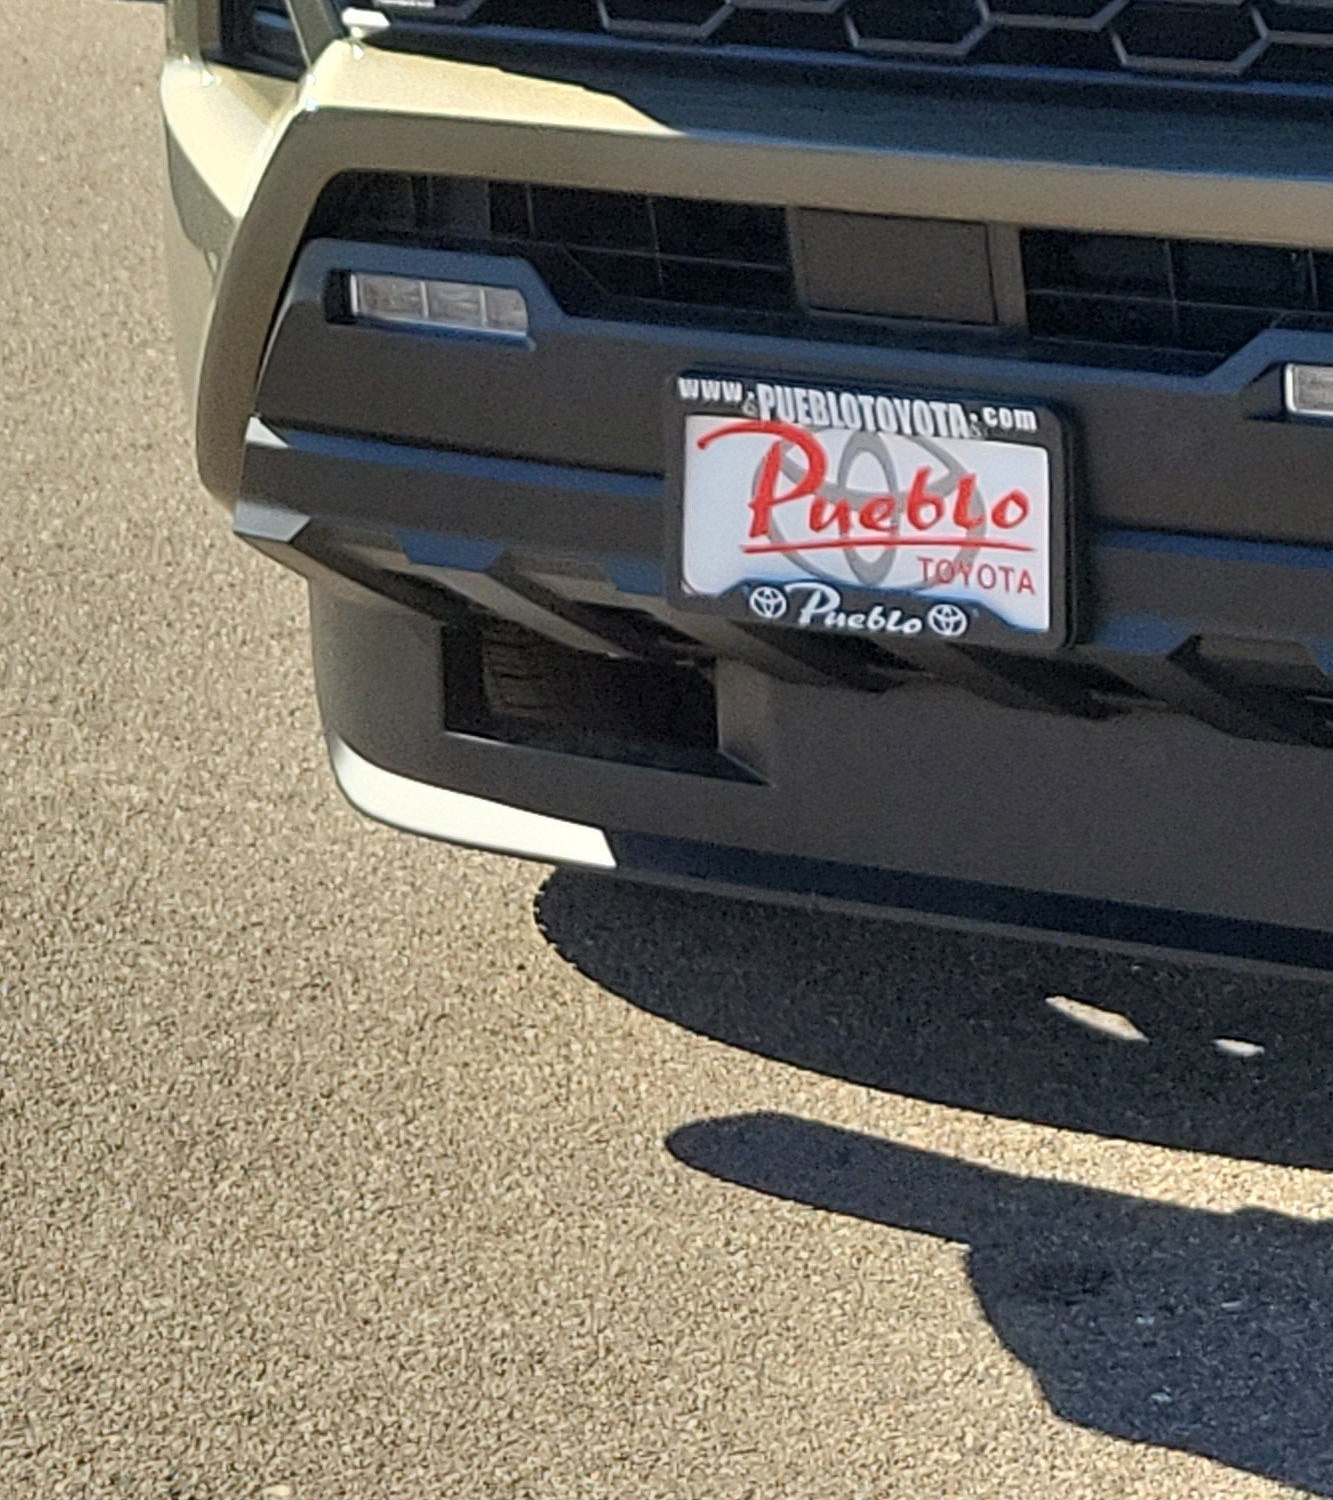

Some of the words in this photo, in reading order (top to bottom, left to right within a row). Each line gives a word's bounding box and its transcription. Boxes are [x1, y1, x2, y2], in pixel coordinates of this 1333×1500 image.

[696, 420, 1031, 538] Pueblo
[916, 556, 1037, 596] TOYOTA
[783, 581, 924, 635] Pueblo
